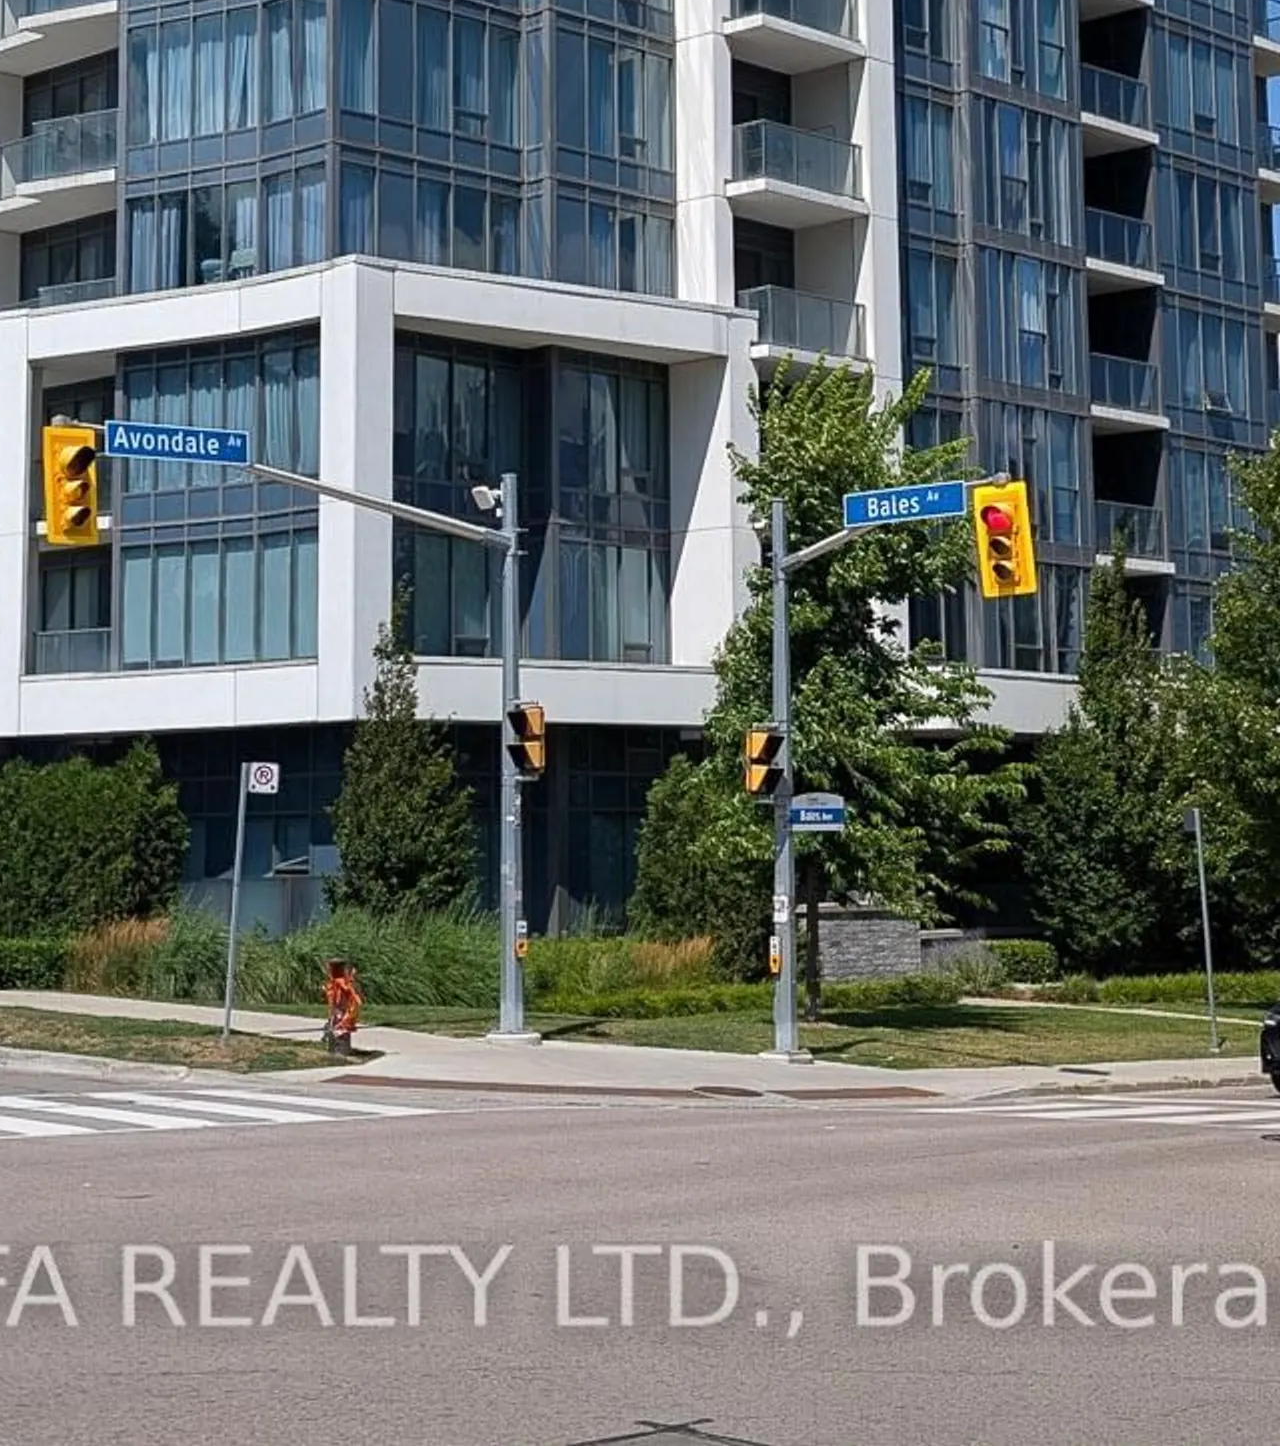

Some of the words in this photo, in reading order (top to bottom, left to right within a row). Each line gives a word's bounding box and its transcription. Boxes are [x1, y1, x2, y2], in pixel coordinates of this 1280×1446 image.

[114, 426, 220, 455] Avondale
[227, 435, 242, 448] Av
[867, 494, 920, 518] Bales
